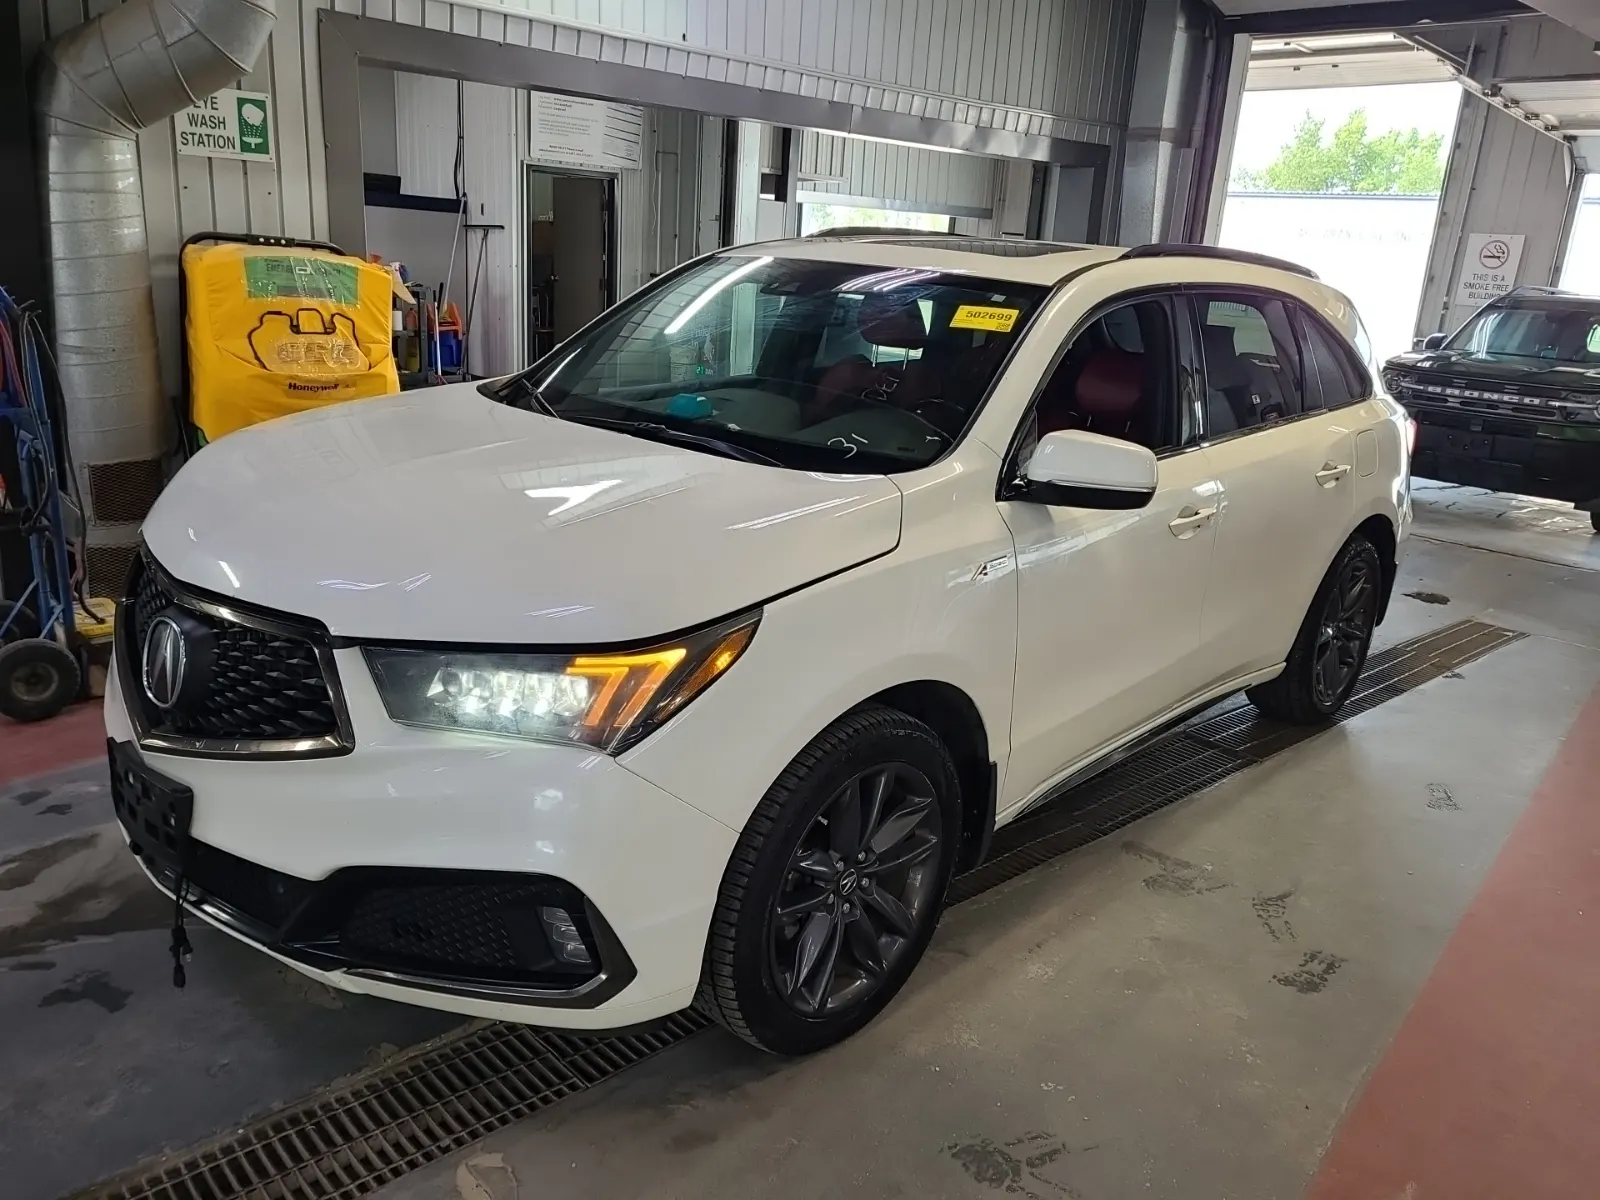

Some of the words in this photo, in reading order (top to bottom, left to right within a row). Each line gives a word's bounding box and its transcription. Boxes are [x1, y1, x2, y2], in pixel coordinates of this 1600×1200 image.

[193, 97, 219, 111] YE
[187, 112, 226, 130] WASH
[180, 131, 236, 150] STATION
[1472, 273, 1489, 282] THIS
[1491, 274, 1499, 282] IS
[1500, 274, 1505, 282] A
[1463, 281, 1490, 291] SMOKE
[1492, 284, 1510, 292] FREE
[965, 310, 1013, 322] 502699
[1427, 386, 1541, 405] BRONCO
